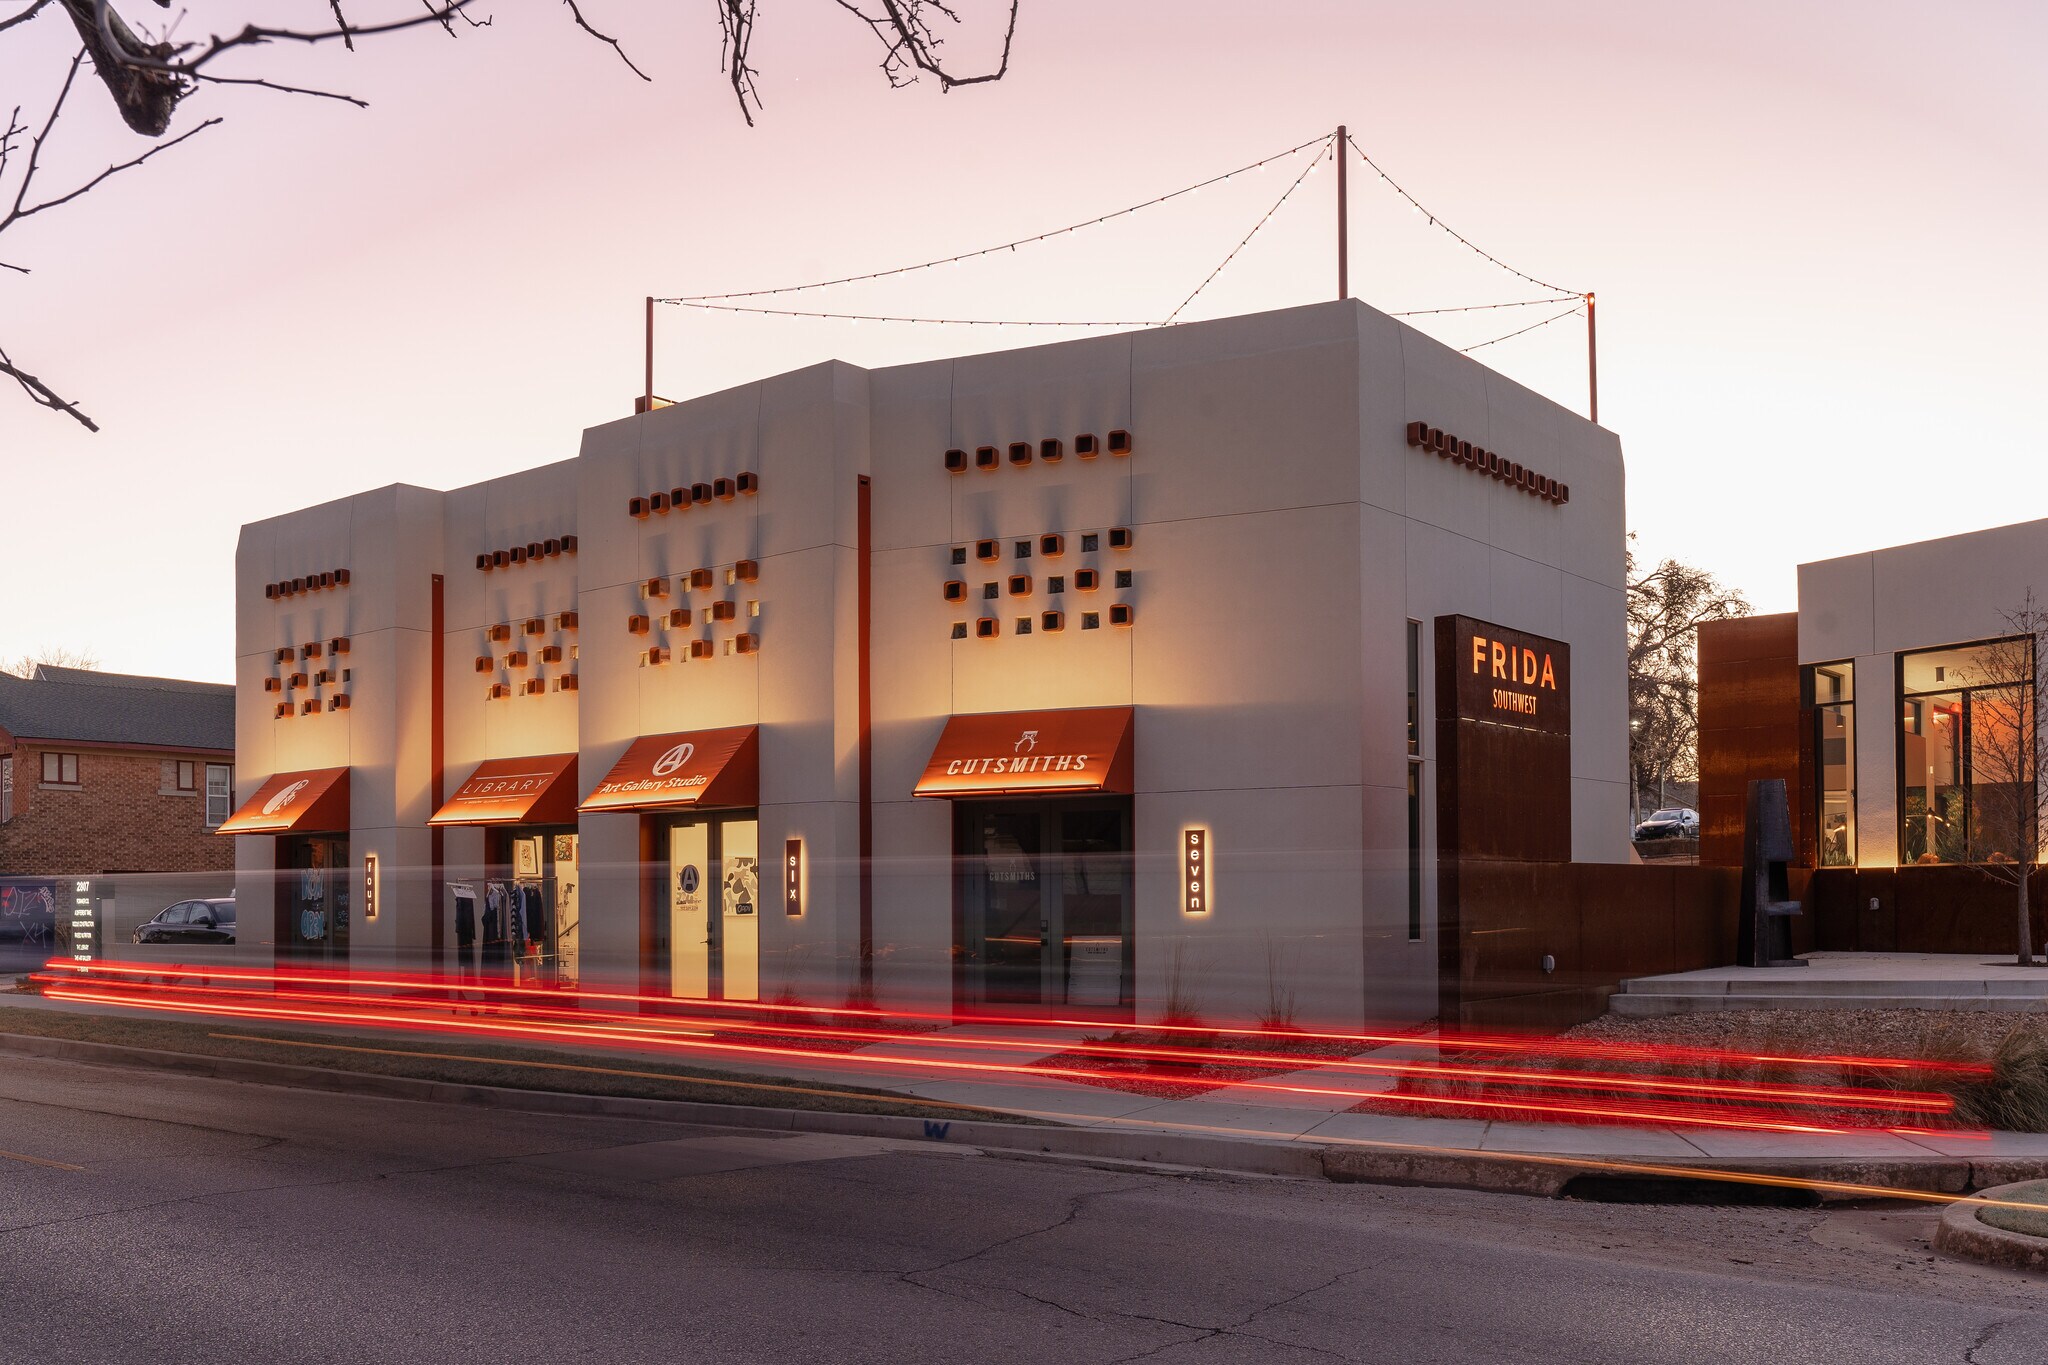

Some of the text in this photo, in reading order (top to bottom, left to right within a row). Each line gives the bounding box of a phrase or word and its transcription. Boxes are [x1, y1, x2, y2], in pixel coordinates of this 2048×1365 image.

[1473, 636, 1556, 690] FRIDA
[1493, 688, 1537, 715] SOUTHWEST
[946, 754, 1088, 775] CUTSMITHS
[462, 779, 548, 794] LIBRARY
[599, 775, 708, 794] Art Gallery Studio
[989, 871, 1036, 881] CUTSMITHS
[1190, 833, 1200, 908] seven
[76, 881, 90, 892] 2807
[301, 909, 324, 940] OPEN
[923, 1120, 951, 1139] W
